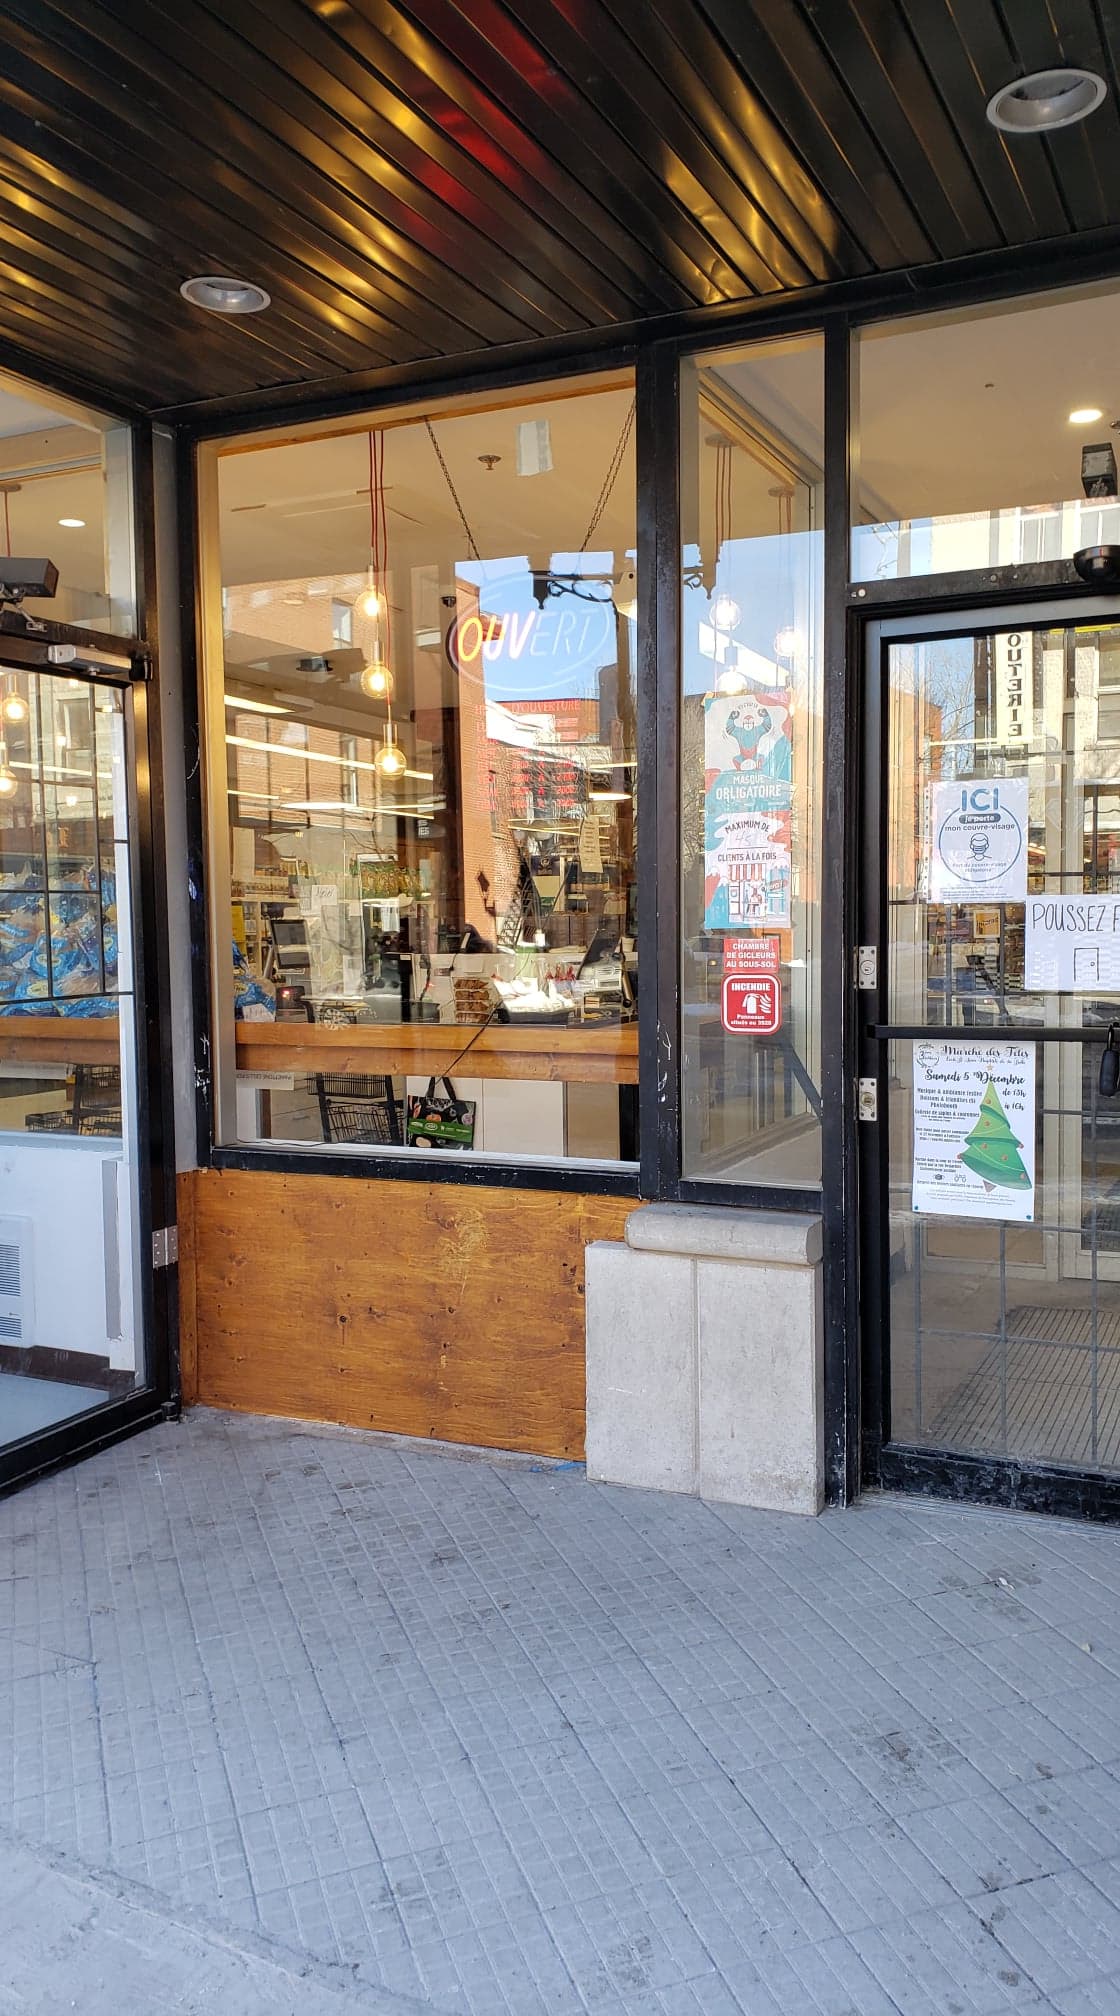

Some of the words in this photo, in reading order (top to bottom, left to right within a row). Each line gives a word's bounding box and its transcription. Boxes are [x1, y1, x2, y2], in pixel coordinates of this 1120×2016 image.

[457, 609, 599, 662] OUVERT
[733, 774, 765, 784] MASQUE
[716, 784, 782, 801] OBLIGATOIRE
[962, 788, 999, 812] ICI
[725, 820, 761, 834] MAXIMUM
[761, 822, 771, 832] DE
[963, 824, 1015, 832] couvre-visage
[718, 852, 744, 862] CLIENTS
[752, 852, 761, 860] LA
[762, 852, 777, 860] FOIS
[1032, 904, 1107, 932] POUSSEZ
[738, 960, 776, 968] SOUS-SOL
[731, 983, 771, 991] INCENDIE
[924, 1068, 961, 1082] Samedi
[973, 1070, 1025, 1084] Décembre
